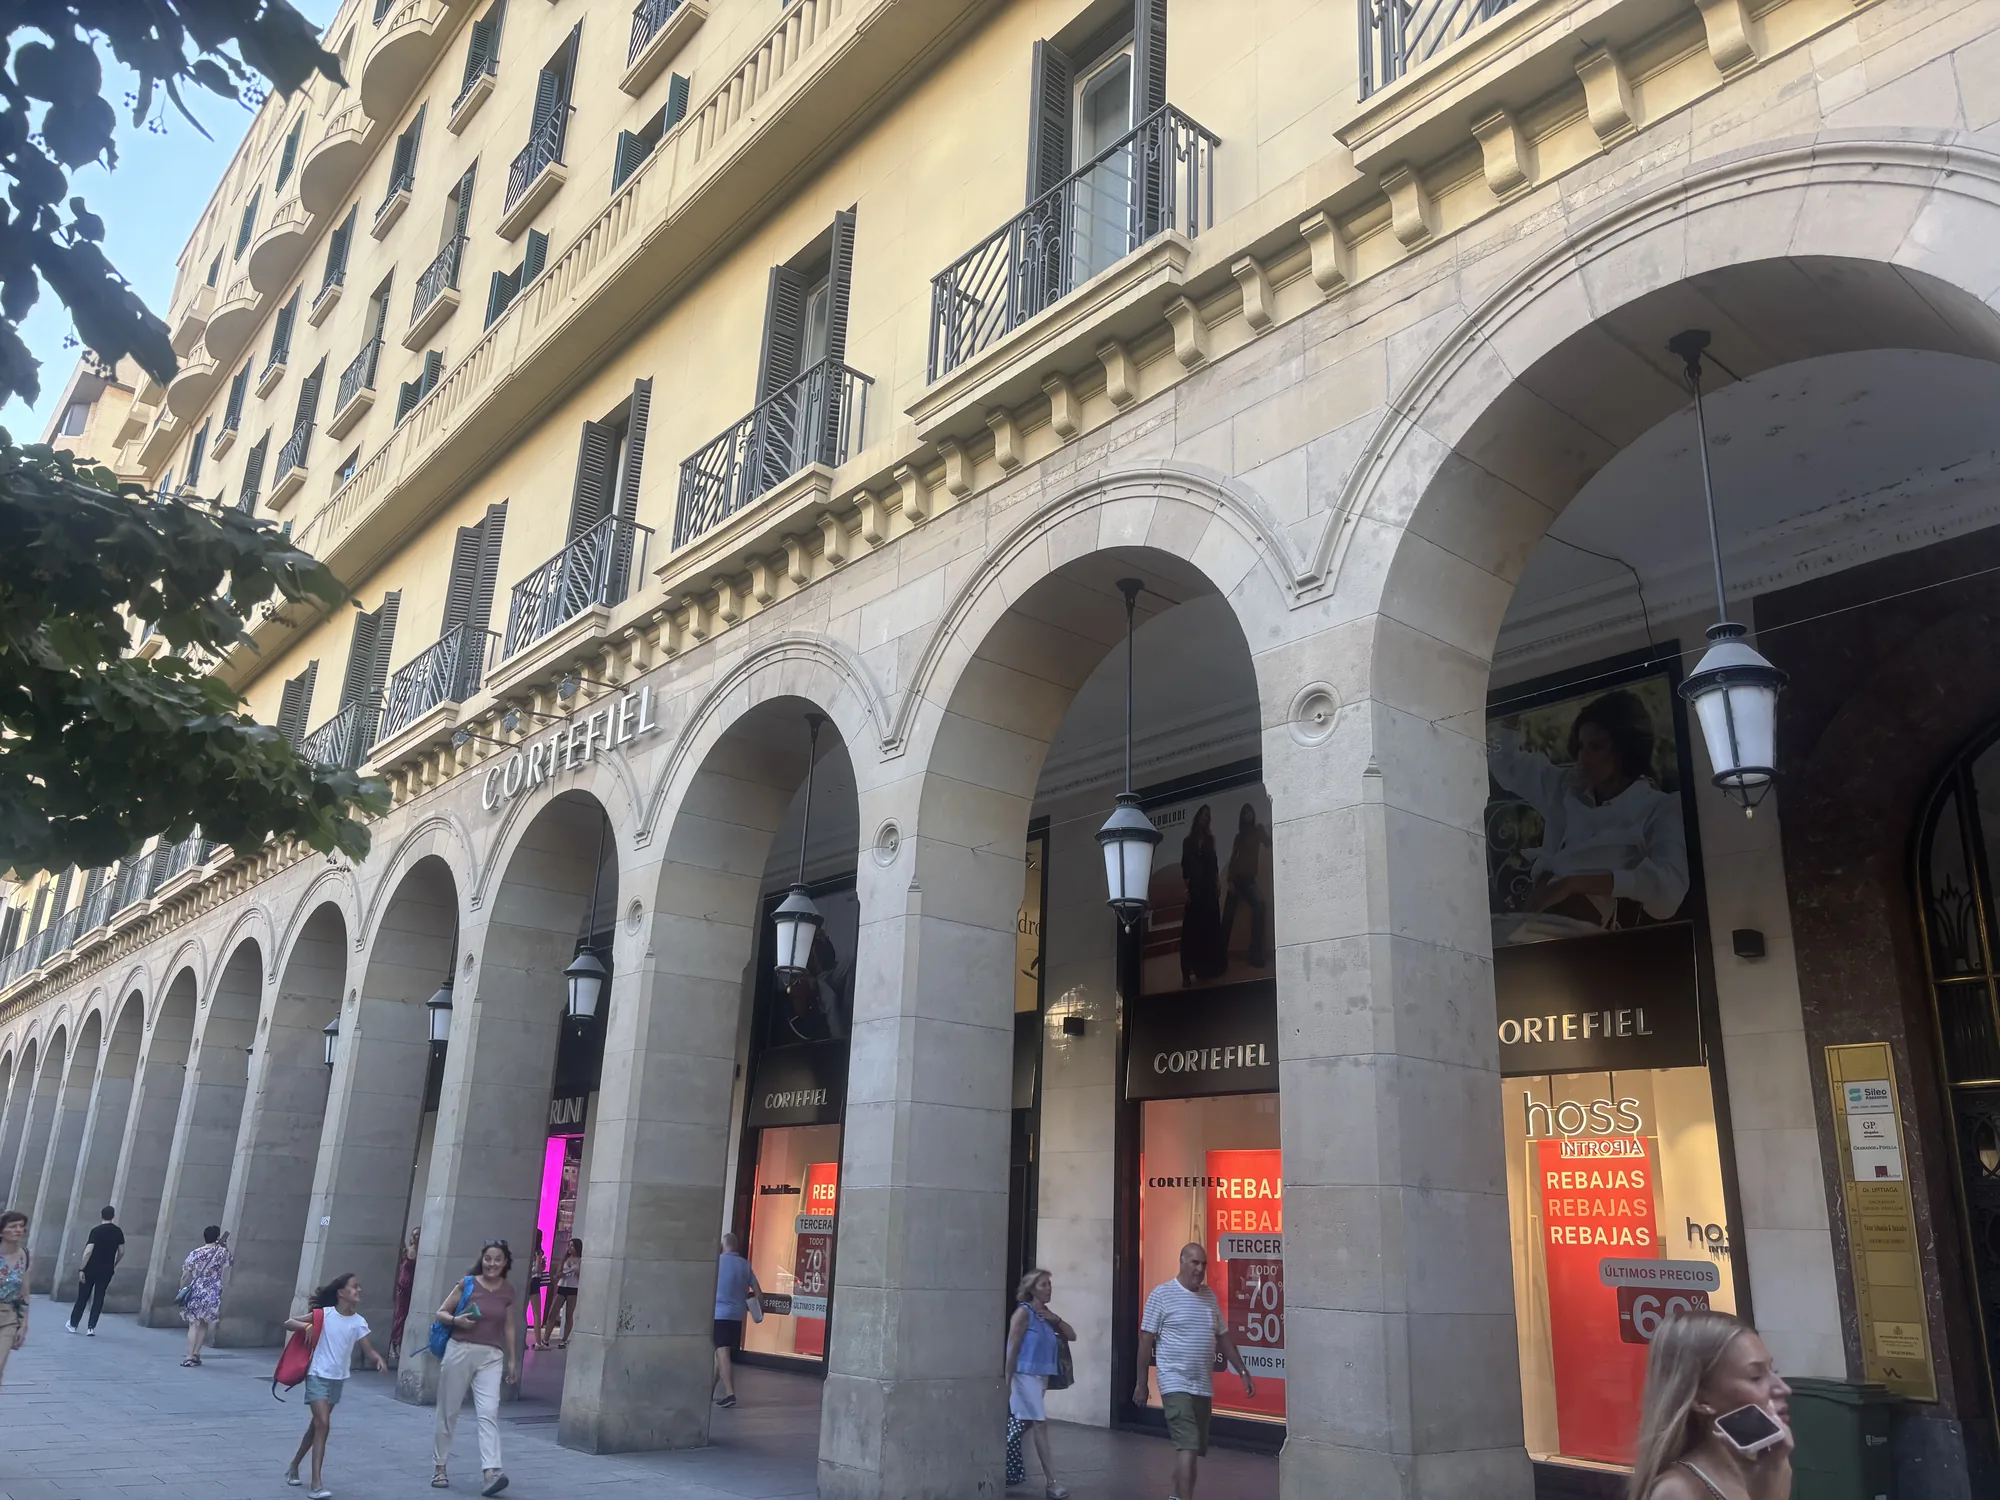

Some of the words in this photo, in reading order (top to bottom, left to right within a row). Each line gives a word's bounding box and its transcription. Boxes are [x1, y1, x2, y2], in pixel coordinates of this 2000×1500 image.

[481, 685, 659, 811] CORTEFIEL
[1498, 1007, 1653, 1045] ORTEFIEL
[1153, 1043, 1271, 1074] CORTEFIEL
[764, 1088, 828, 1109] CORTEFIEL
[1864, 1088, 1887, 1096] Sileo
[1523, 1090, 1643, 1136] hoss
[1149, 1176, 1224, 1188] CORTEFIEL
[1547, 1170, 1645, 1189] REBAJAS
[1549, 1198, 1648, 1217] REBAJAS
[1551, 1226, 1650, 1246] REBAJAS
[1686, 1216, 1728, 1243] ho
[1228, 1239, 1281, 1254] TERCER
[1604, 1264, 1656, 1279] ÚLTIMOS
[1659, 1269, 1714, 1282] PRECIOS
[1243, 1354, 1273, 1368] TIMOS
